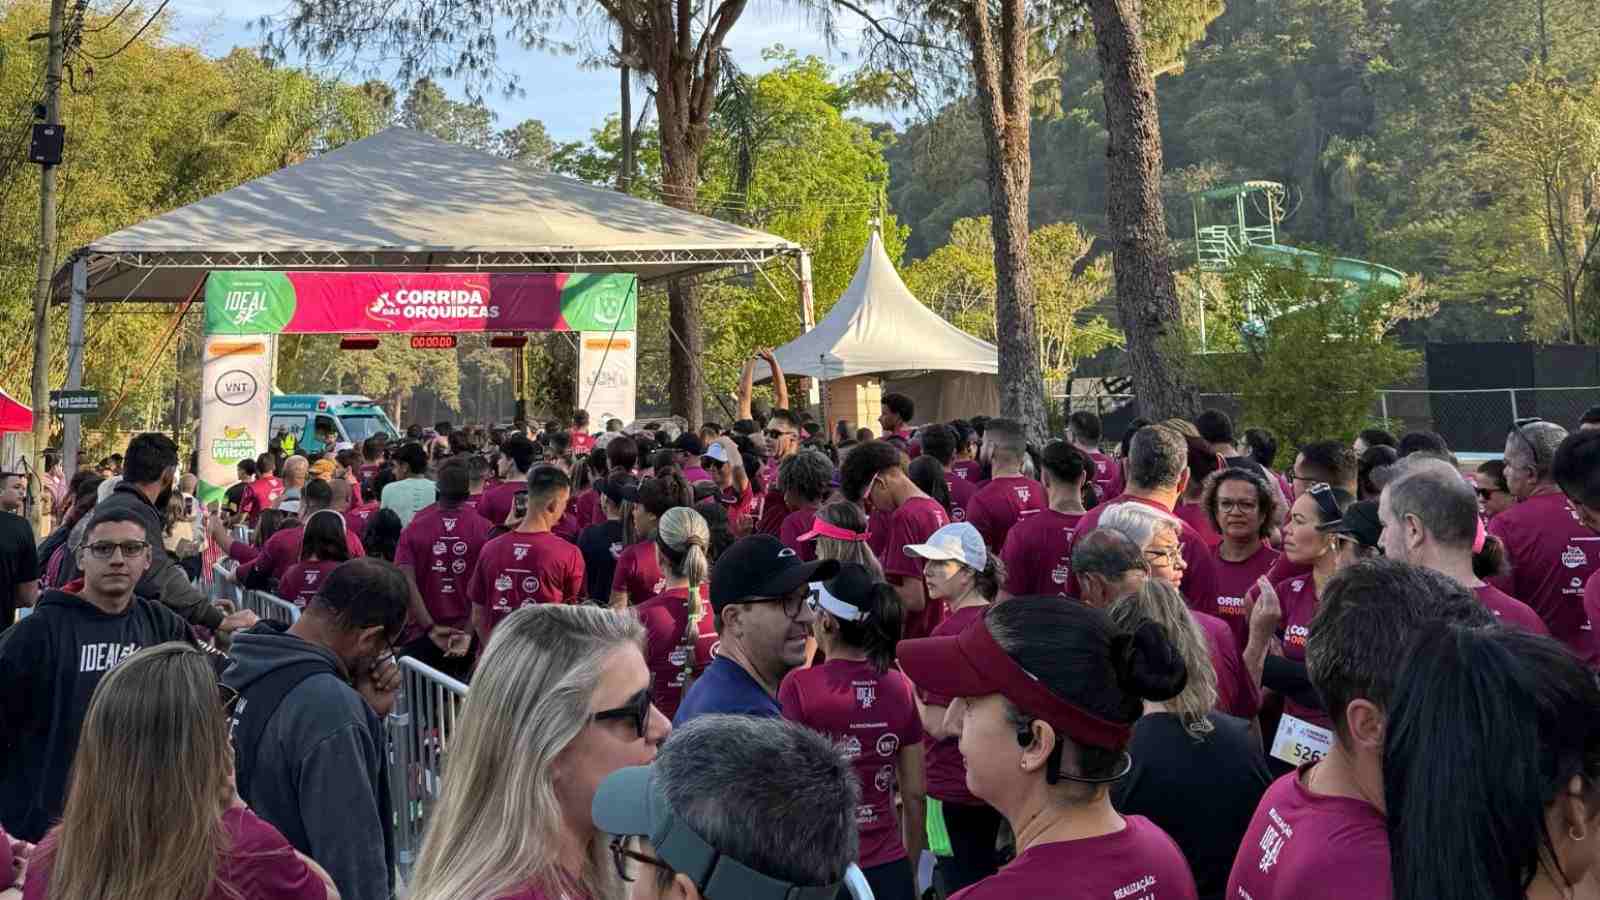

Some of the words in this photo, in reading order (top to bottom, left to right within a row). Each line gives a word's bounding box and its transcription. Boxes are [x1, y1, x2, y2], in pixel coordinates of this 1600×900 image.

[224, 291, 267, 311] IDEAL
[395, 289, 483, 305] CORRIDA
[225, 383, 248, 392] VNT
[212, 447, 256, 459] Wilson
[1259, 823, 1285, 865] IDEAL
